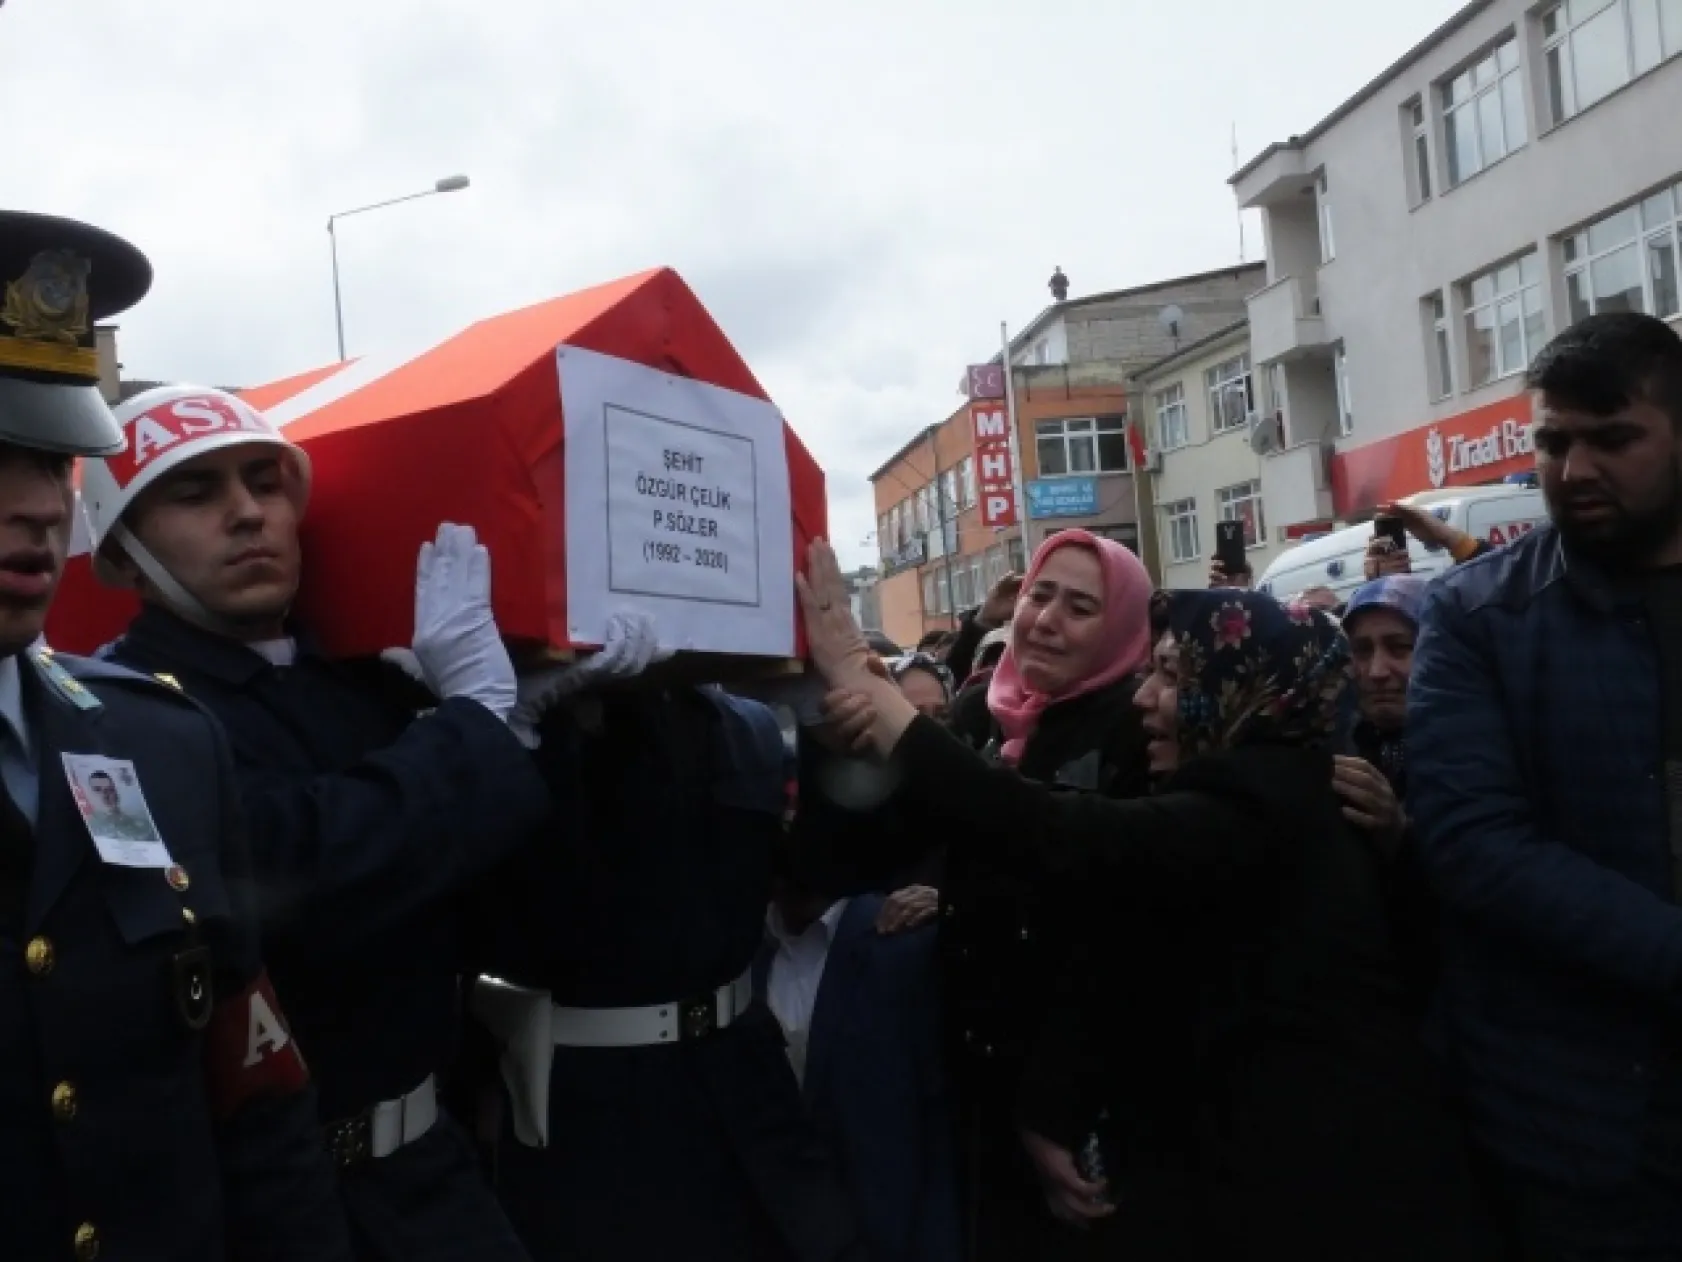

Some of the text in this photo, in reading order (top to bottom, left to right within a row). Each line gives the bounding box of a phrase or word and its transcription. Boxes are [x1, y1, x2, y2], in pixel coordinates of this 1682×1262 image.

[663, 449, 704, 475] ŞEHİT
[1447, 425, 1503, 472] Ziraat
[635, 470, 731, 511] ÖZGÜR ÇELİK
[642, 540, 681, 563] (1992
[694, 547, 728, 574] 2020)
